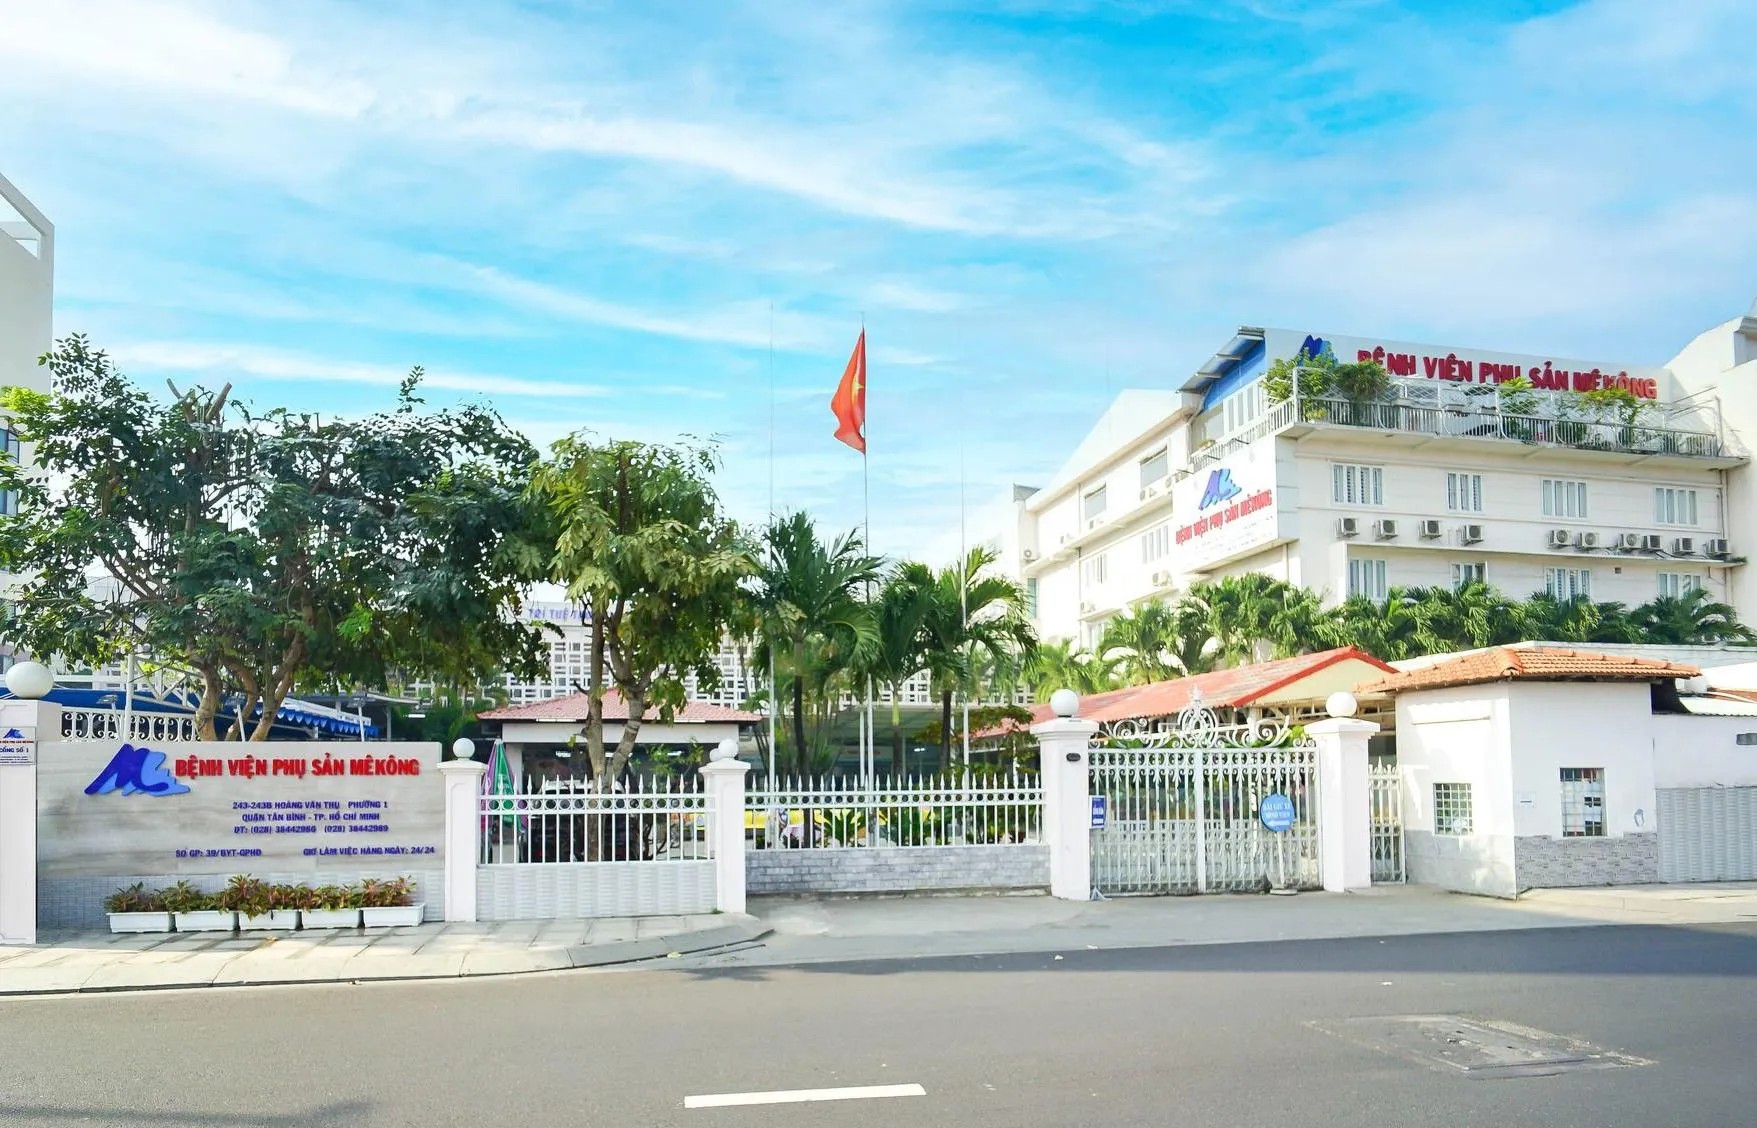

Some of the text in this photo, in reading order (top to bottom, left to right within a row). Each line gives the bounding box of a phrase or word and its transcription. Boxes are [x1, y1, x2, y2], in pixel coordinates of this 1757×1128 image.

[1528, 361, 1569, 391] SẢN
[1193, 516, 1209, 538] VIỆN
[1209, 511, 1223, 530] PHỤ
[1224, 499, 1239, 524] SẢN
[174, 752, 421, 780] BỆNH VIỆN PHỤ SẢN MÊKÔNG
[232, 801, 272, 809] 243-243B
[274, 800, 303, 809] HOÀNG
[383, 801, 388, 809] 1
[267, 812, 284, 821] TÂN
[286, 812, 306, 821] BÌNH
[342, 811, 357, 821] CHÍ
[359, 813, 380, 821] MINH
[319, 846, 338, 856] LÀM
[360, 846, 383, 856] HÀNG
[410, 846, 435, 855] 24/24
